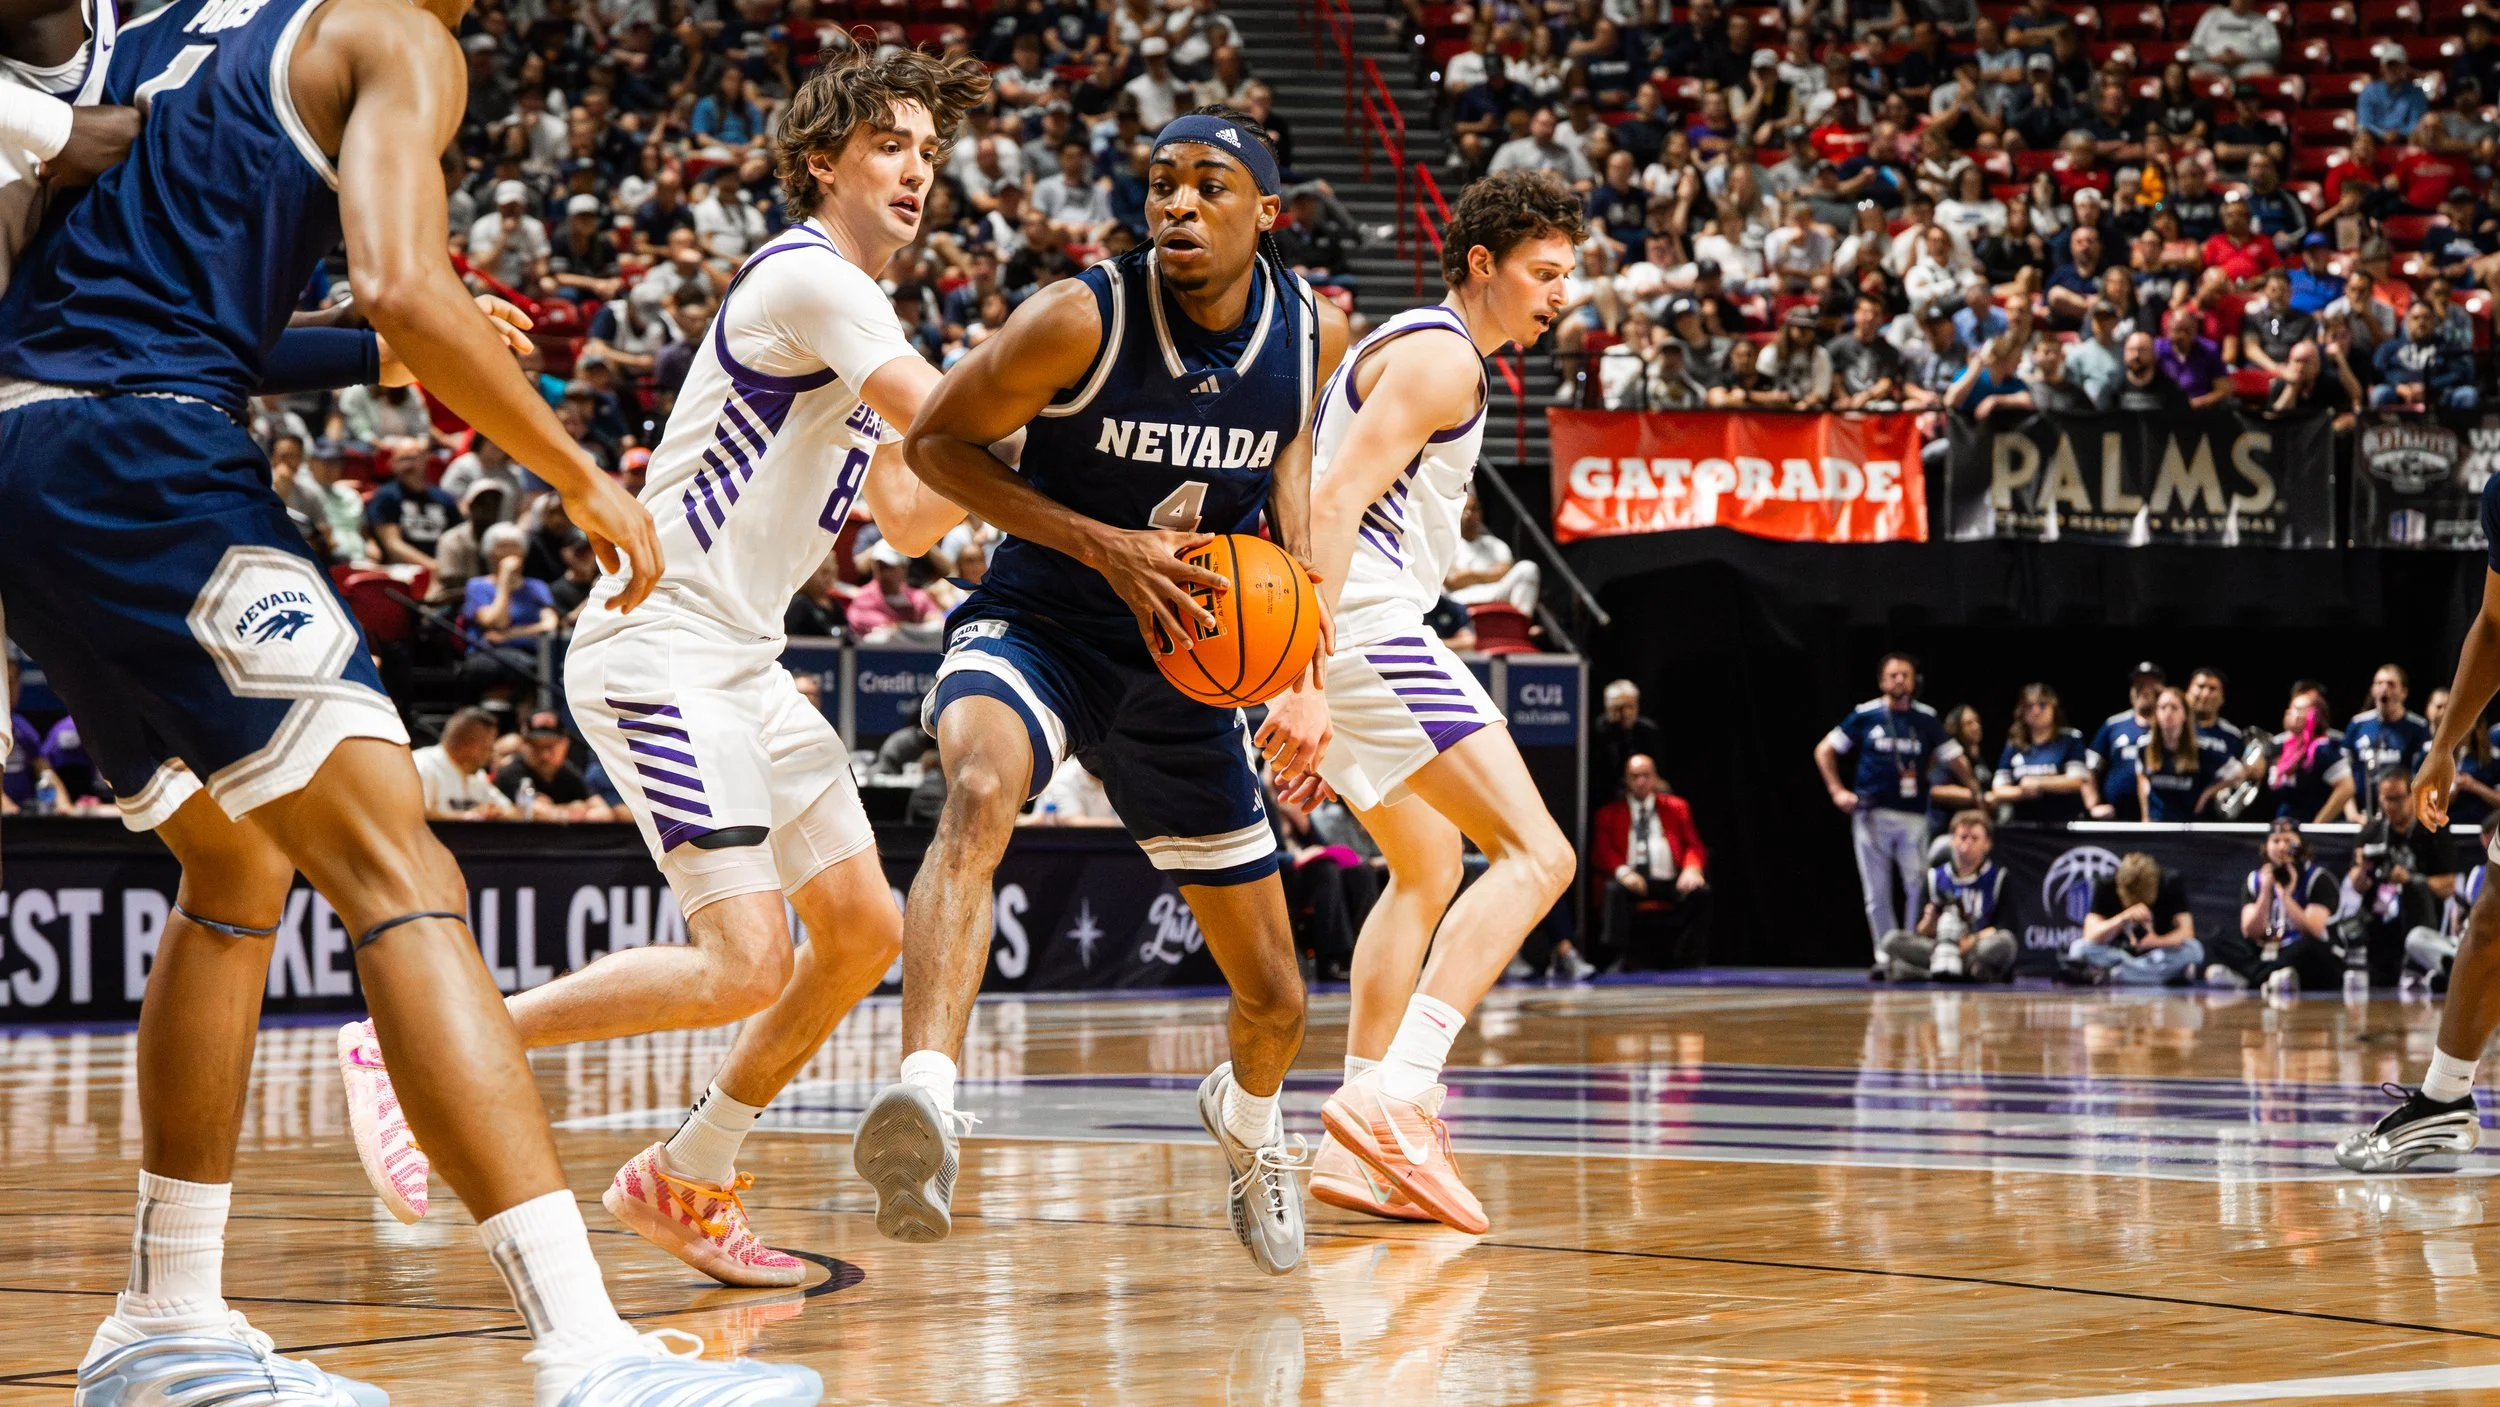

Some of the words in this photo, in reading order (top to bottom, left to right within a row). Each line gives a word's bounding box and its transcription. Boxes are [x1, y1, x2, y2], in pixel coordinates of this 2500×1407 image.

[1215, 131, 1242, 149] adidas
[1095, 417, 1278, 469] NEVADA
[818, 447, 870, 534] 8
[1569, 456, 1902, 503] GATORADE
[1989, 432, 2276, 514] PALMS
[1147, 480, 1209, 532] 4
[234, 590, 313, 639] NEVADA
